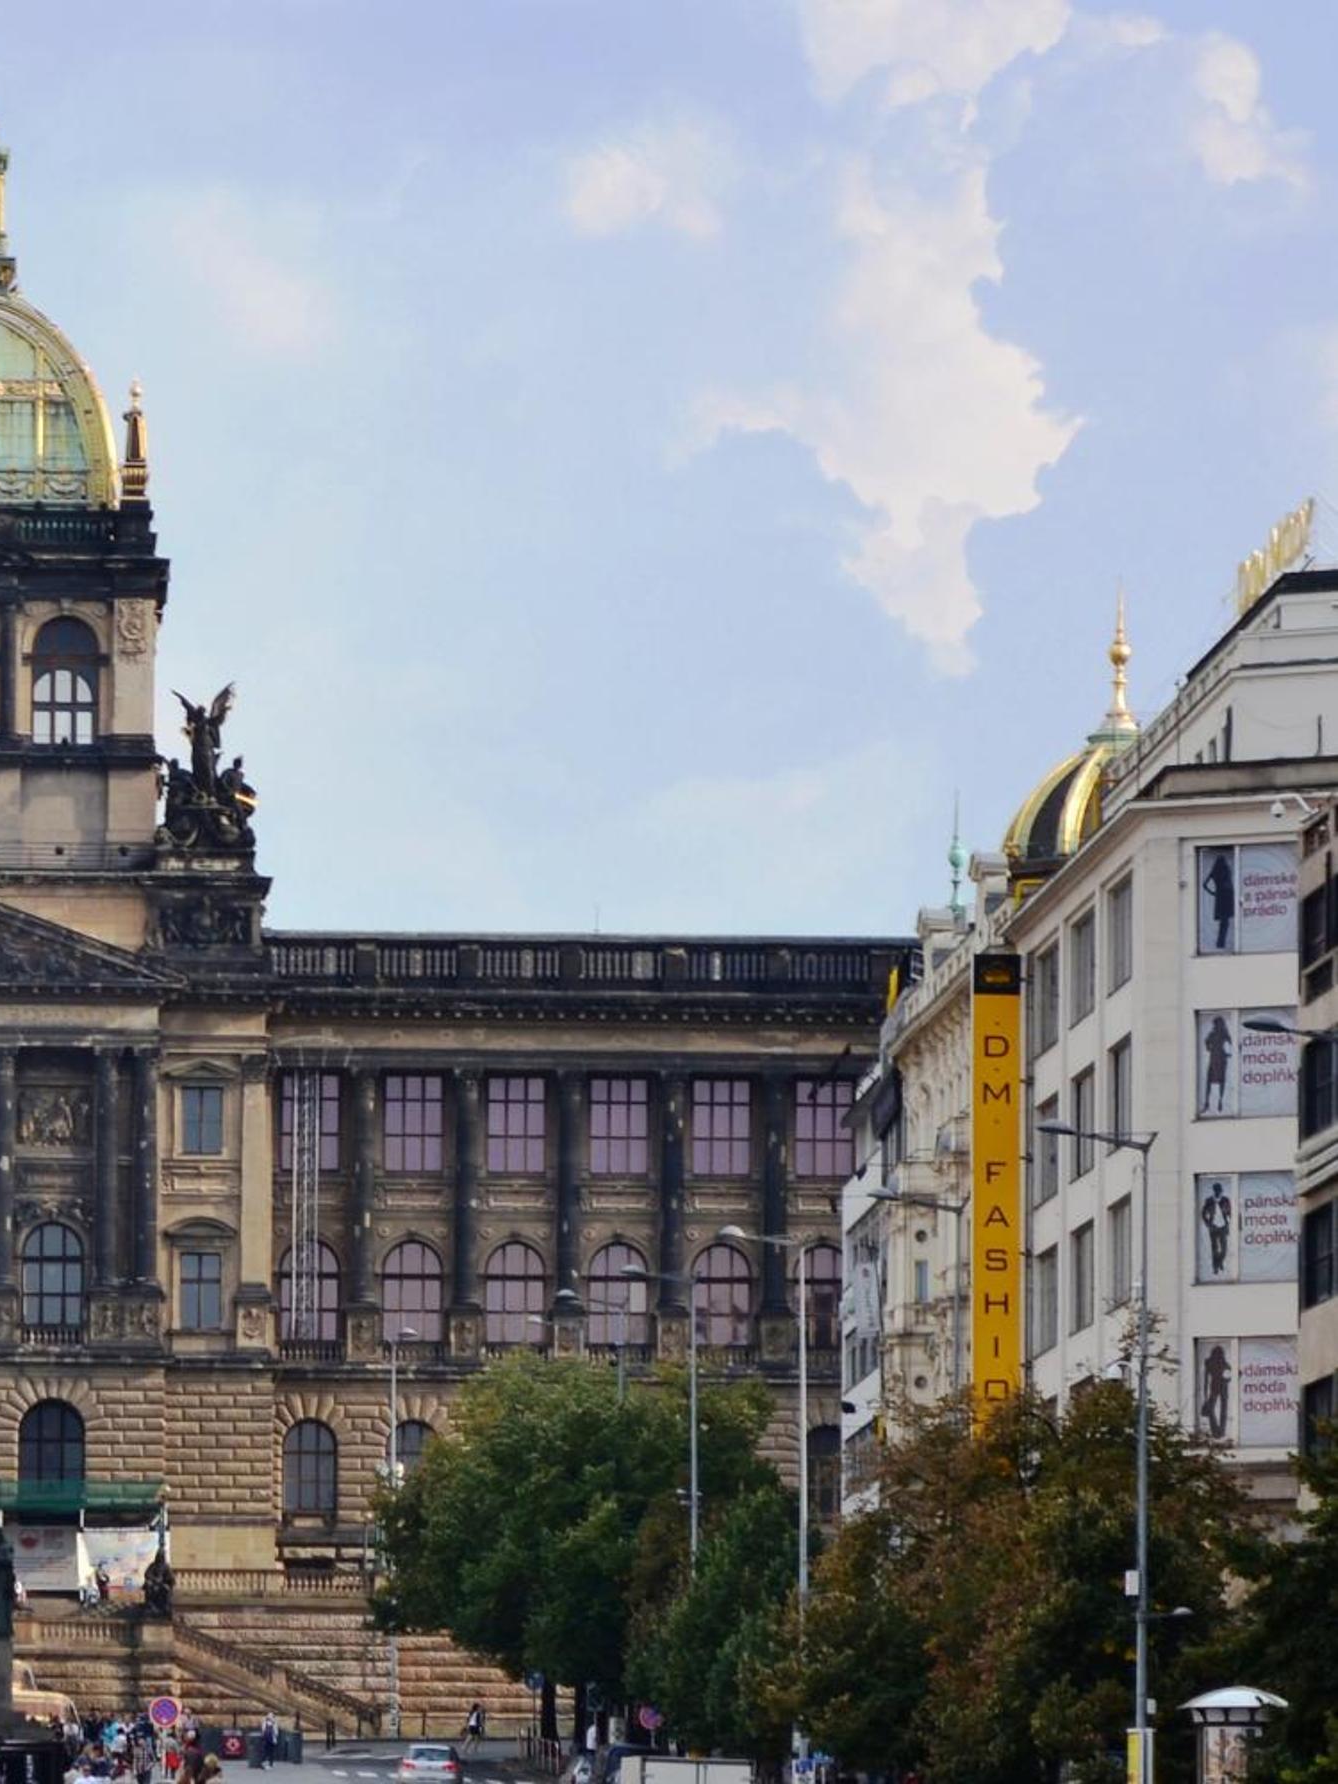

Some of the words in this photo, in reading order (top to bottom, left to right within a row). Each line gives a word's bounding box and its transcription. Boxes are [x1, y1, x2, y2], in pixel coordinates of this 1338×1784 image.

[1254, 889, 1297, 903] pánsk
[1243, 1033, 1297, 1047] dámsk
[1243, 1067, 1297, 1085] doplňk
[983, 1162, 1010, 1402] FASHIO
